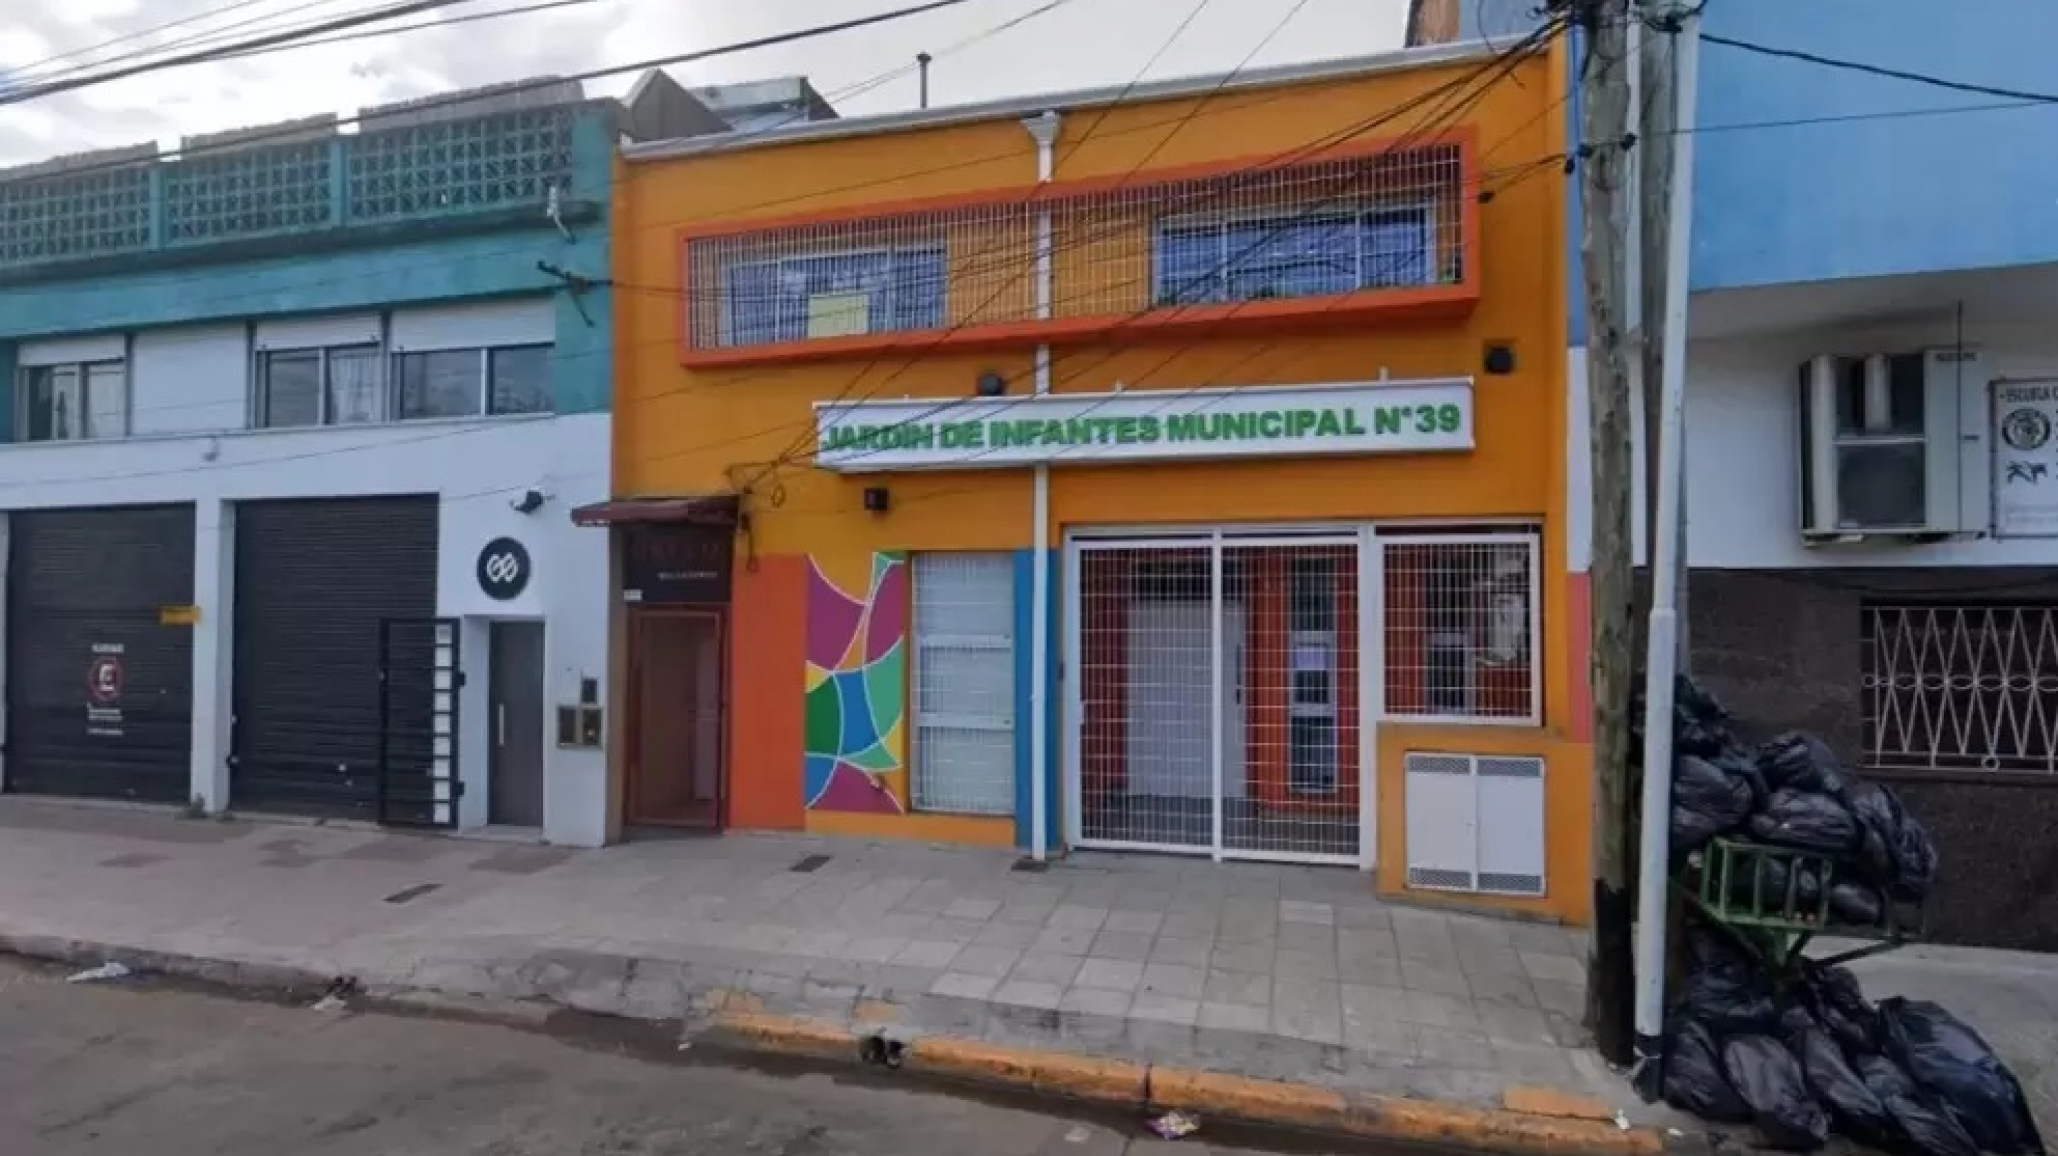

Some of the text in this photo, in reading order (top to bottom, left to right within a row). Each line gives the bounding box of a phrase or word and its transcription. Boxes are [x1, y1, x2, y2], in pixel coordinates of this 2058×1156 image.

[822, 423, 933, 450] JARDIN
[940, 420, 984, 448] DE
[990, 415, 1161, 448] INFANTES
[1166, 408, 1366, 442] MUNICIPAL
